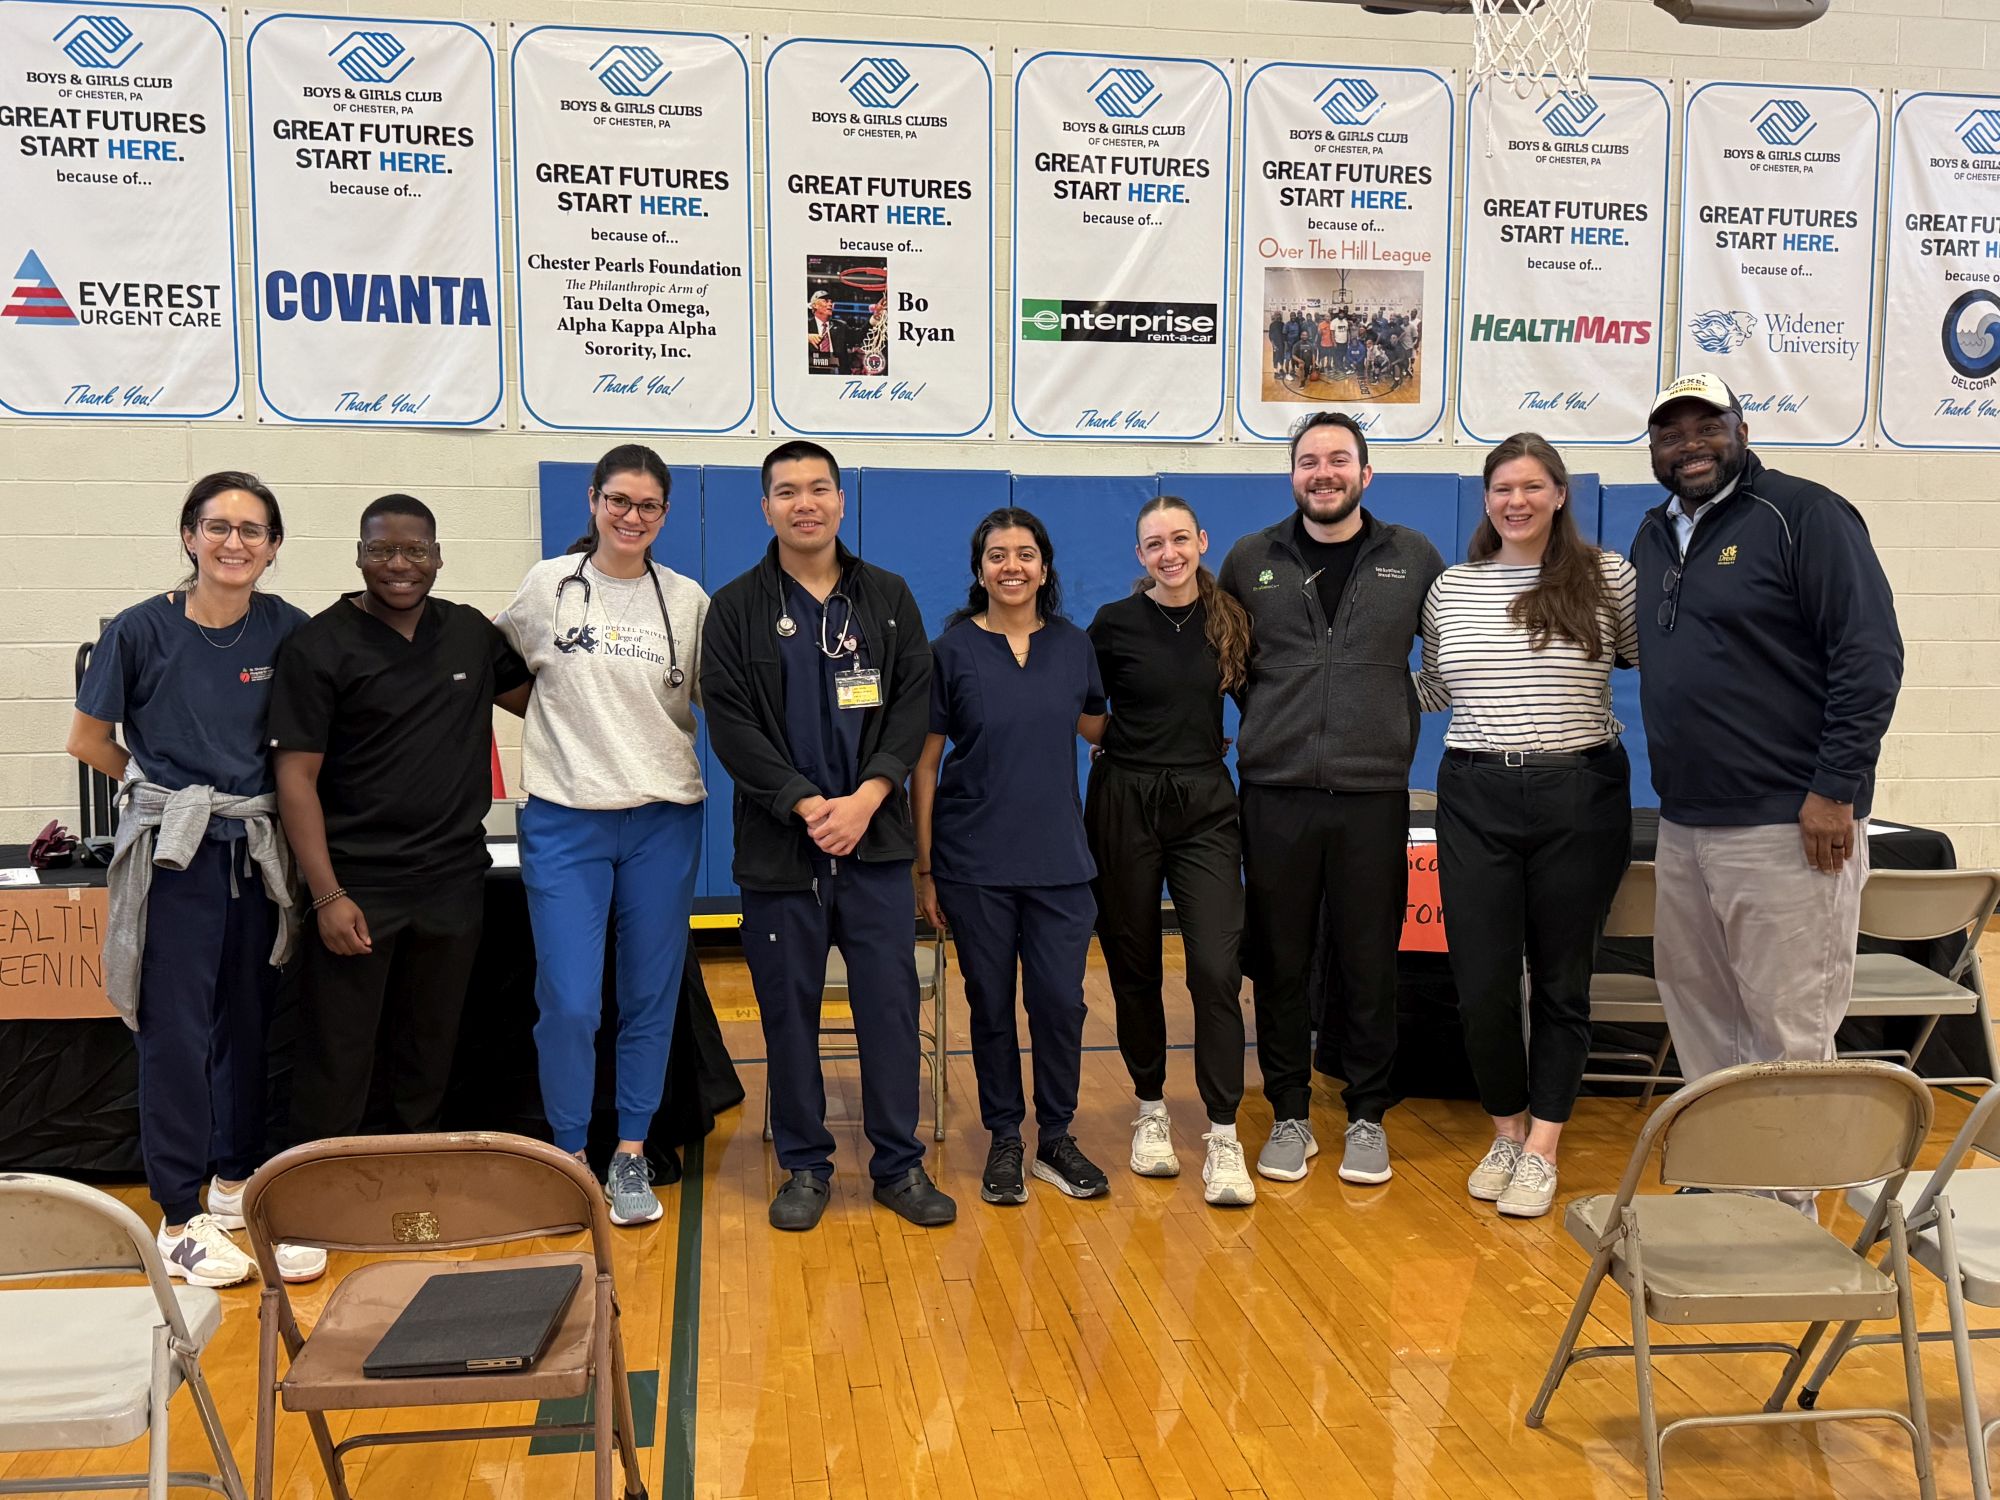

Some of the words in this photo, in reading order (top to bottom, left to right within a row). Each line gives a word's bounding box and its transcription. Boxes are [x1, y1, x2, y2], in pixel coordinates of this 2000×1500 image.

[27, 72, 66, 84] BOYS
[70, 74, 82, 85] &
[86, 75, 129, 87] GIRLS
[134, 77, 172, 88] CLUB
[58, 89, 72, 97] OF
[76, 90, 127, 101] CHESTER,
[130, 92, 143, 101] PA
[303, 87, 341, 98] BOYS
[345, 88, 356, 99] &
[359, 89, 401, 101] GIRLS
[406, 91, 442, 102] CLUB
[333, 103, 346, 112] OF
[349, 104, 398, 115] CHESTER,
[402, 106, 413, 114] PA
[561, 100, 597, 111] BOYS
[600, 102, 612, 112] &
[615, 103, 655, 114] GIRLS
[658, 105, 702, 116] CLUBS
[0, 106, 81, 128] GREAT
[87, 110, 206, 134] FUTURES
[593, 117, 606, 125] OF
[609, 117, 656, 128] CHESTER,
[659, 120, 670, 128] PA
[812, 112, 846, 123] BOYS
[850, 114, 860, 124] &
[864, 114, 902, 125] GIRLS
[906, 116, 947, 127] CLUBS
[1063, 122, 1096, 133] BOYS
[1099, 123, 1109, 133] &
[1112, 124, 1148, 135] GIRLS
[1152, 126, 1185, 135] CLUB
[273, 119, 354, 142] GREAT
[360, 124, 474, 147] FUTURES
[843, 128, 856, 136] OF
[858, 129, 903, 139] CHESTER,
[906, 131, 917, 139] PA
[1089, 137, 1100, 145] OF
[1103, 138, 1146, 148] CHESTER,
[1290, 130, 1322, 140] BOYS
[1325, 131, 1335, 141] &
[1338, 131, 1374, 142] GIRLS
[1377, 133, 1408, 143] CLUB
[20, 135, 99, 158] START
[108, 139, 184, 161] HERE.
[1328, 145, 1370, 155] CHESTER,
[1508, 141, 1539, 151] BOYS
[1542, 142, 1552, 151] &
[1554, 142, 1588, 153] GIRLS
[1592, 144, 1629, 154] CLUBS
[1724, 149, 1754, 159] BOYS
[1756, 150, 1765, 160] &
[1768, 151, 1801, 161] GIRLS
[1804, 152, 1840, 162] CLUBS
[296, 148, 371, 170] START
[380, 152, 452, 174] HERE.
[1035, 152, 1107, 174] GREAT
[1112, 156, 1209, 178] FUTURES
[1549, 156, 1588, 166] CHESTER,
[1750, 163, 1761, 171] OF
[1763, 164, 1801, 173] CHESTER,
[57, 169, 118, 184] because
[123, 172, 151, 185] of...
[536, 163, 614, 185] GREAT
[620, 167, 729, 190] FUTURES
[1263, 161, 1332, 181] GREAT
[1336, 163, 1432, 184] FUTURES
[788, 174, 862, 195] GREAT
[868, 177, 971, 199] FUTURES
[1054, 180, 1121, 200] START
[1128, 183, 1189, 203] HERE.
[558, 192, 632, 213] START
[641, 195, 708, 217] HERE.
[1280, 187, 1345, 207] START
[1351, 190, 1412, 209] HERE.
[808, 203, 879, 223] START
[887, 206, 951, 226] HERE.
[1083, 211, 1134, 225] because
[1138, 214, 1162, 225] of...
[1484, 199, 1551, 218] GREAT
[1555, 201, 1647, 221] FUTURES
[1700, 206, 1764, 225] GREAT
[1768, 208, 1857, 228] FUTURES
[1906, 214, 1968, 232] GREAT
[591, 228, 648, 242] because
[652, 231, 678, 243] of...
[1500, 225, 1564, 244] START
[1571, 227, 1628, 246] HERE.
[1716, 231, 1777, 250] START
[1783, 233, 1838, 252] HERE.
[1259, 237, 1303, 258] Over
[1308, 238, 1337, 259] The
[1342, 240, 1367, 260] Hill
[1372, 241, 1431, 266] League
[1920, 239, 1980, 257] START
[528, 254, 590, 270] Chester
[595, 257, 644, 273] Pearls
[649, 259, 741, 276] Foundation
[1528, 257, 1576, 270] because
[1579, 259, 1601, 270] of...
[80, 282, 220, 309] EVEREST
[266, 270, 491, 326] COVANTA
[566, 279, 585, 290] The
[589, 280, 665, 295] Philanthropic
[668, 283, 693, 294] Arm
[696, 284, 709, 297] of
[563, 296, 594, 310] Tau
[599, 297, 643, 312] Delta
[647, 299, 709, 318] Omega,
[898, 292, 928, 312] Bo
[81, 309, 163, 326] URGENT
[169, 312, 221, 327] CARE
[557, 317, 606, 335] Alpha
[611, 319, 664, 337] Kappa
[668, 321, 716, 338] Alpha
[1032, 309, 1214, 336] enterprise
[1765, 313, 1845, 334] Widener
[898, 322, 955, 347] Ryan
[1147, 332, 1213, 343] rent-a-car
[585, 341, 656, 360] Sorority,
[661, 344, 691, 358] Inc.
[1768, 334, 1859, 361] University
[593, 374, 643, 394] Thank
[647, 376, 685, 395] You!
[839, 381, 887, 400] Thank
[890, 381, 926, 401] You!
[1951, 375, 1997, 391] DELCORA
[64, 385, 119, 405] Thank
[123, 385, 164, 406] You!
[335, 392, 388, 413] Thank
[391, 394, 430, 414] You!
[1519, 391, 1564, 410] Thank
[1565, 392, 1599, 410] You!
[1076, 410, 1122, 428] Thank
[1125, 410, 1159, 429] You!
[604, 642, 665, 664] Medicine
